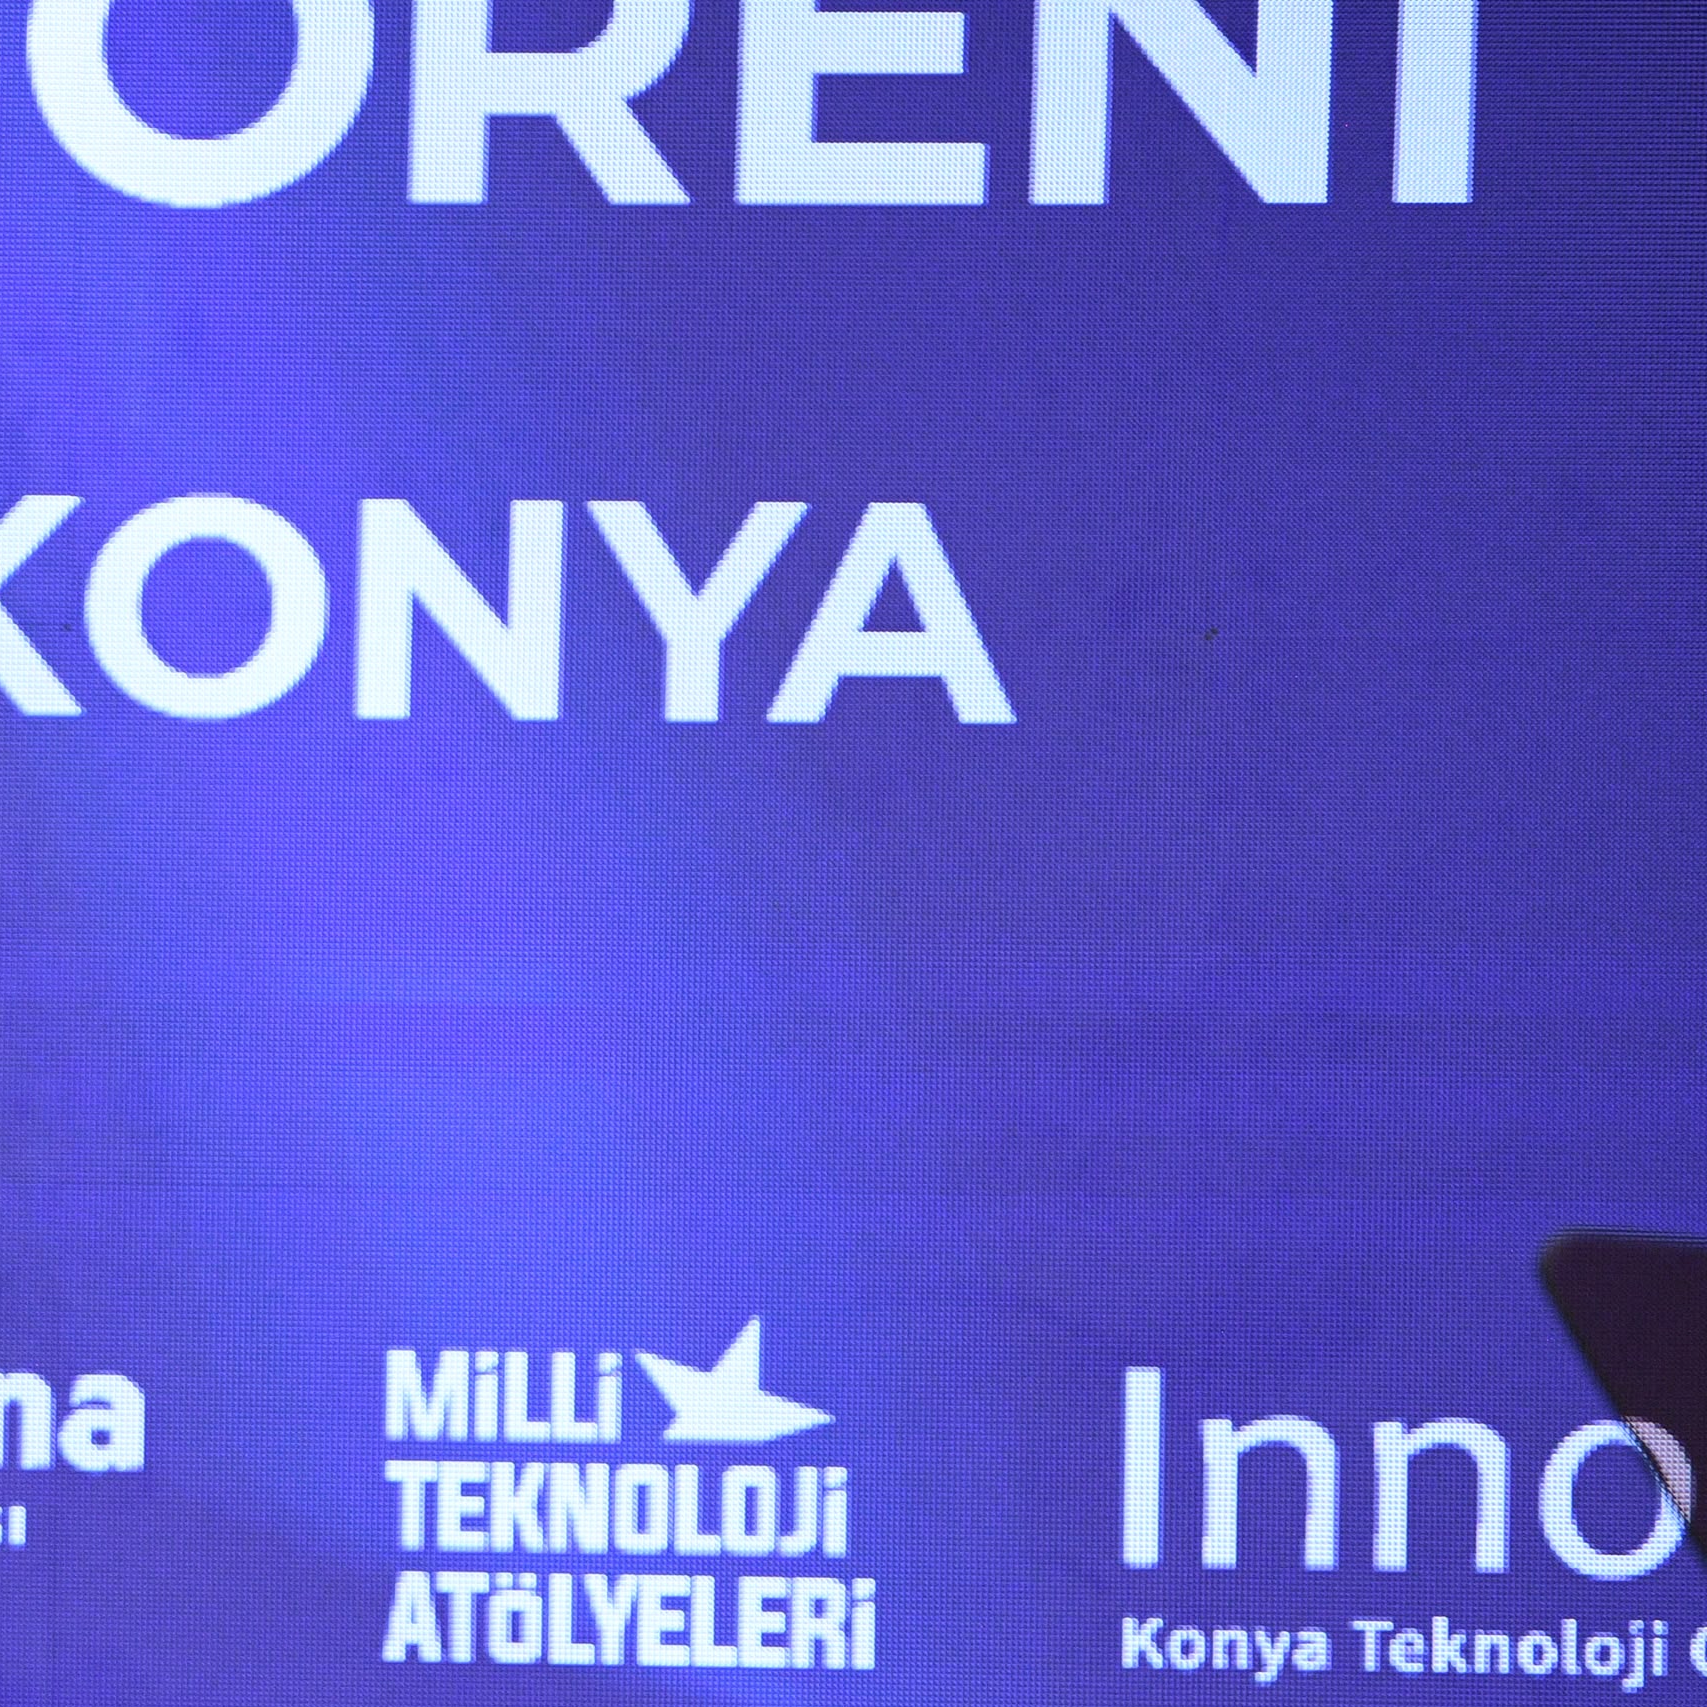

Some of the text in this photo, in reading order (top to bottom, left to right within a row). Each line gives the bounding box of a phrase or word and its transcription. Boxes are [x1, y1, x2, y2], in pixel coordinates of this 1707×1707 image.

[1123, 1367, 1689, 1579] Inno
[1122, 1617, 1328, 1683] Konya
[1352, 1616, 1666, 1691] Teknoloji
